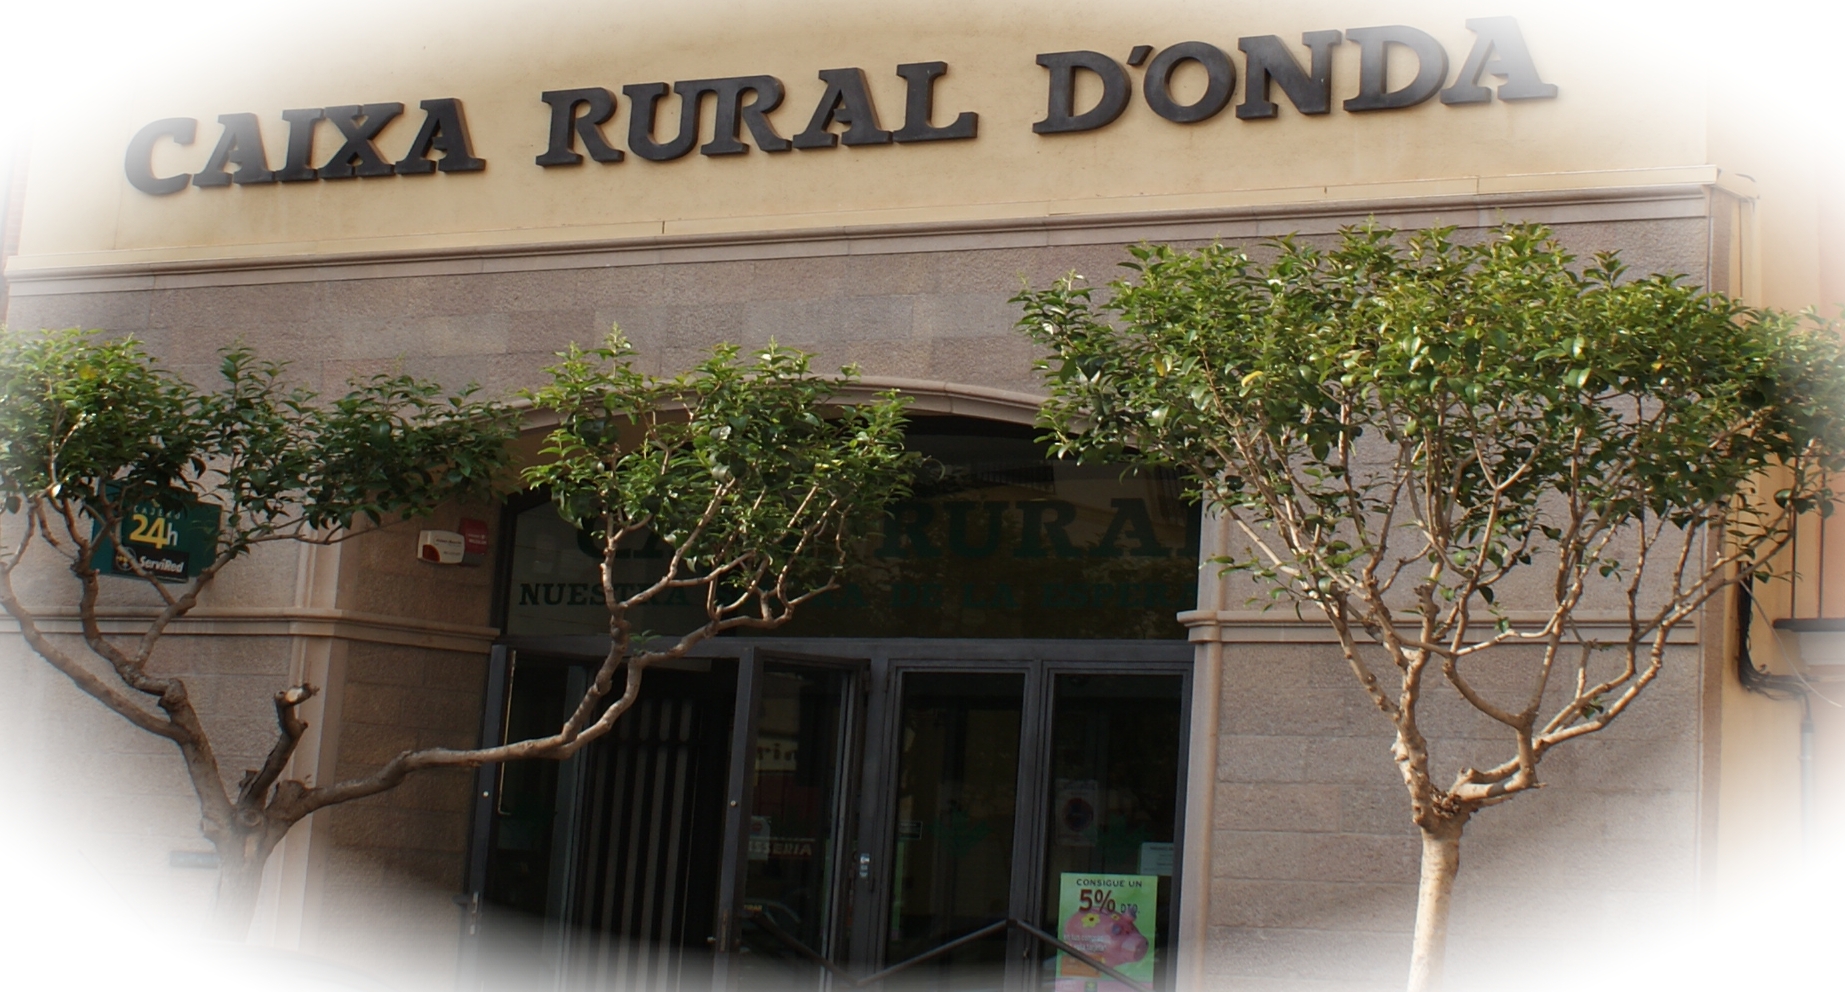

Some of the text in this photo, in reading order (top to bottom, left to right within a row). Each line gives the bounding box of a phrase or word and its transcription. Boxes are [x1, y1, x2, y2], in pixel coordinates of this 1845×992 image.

[124, 16, 1559, 196] CAIXA RURAL D'ONDA
[129, 513, 179, 550] 24h
[139, 555, 185, 574] ServiRed
[891, 583, 943, 608] DE
[962, 583, 1019, 608] LA
[1076, 878, 1143, 888] CONSIGUE UN
[1078, 888, 1116, 913] 5%
